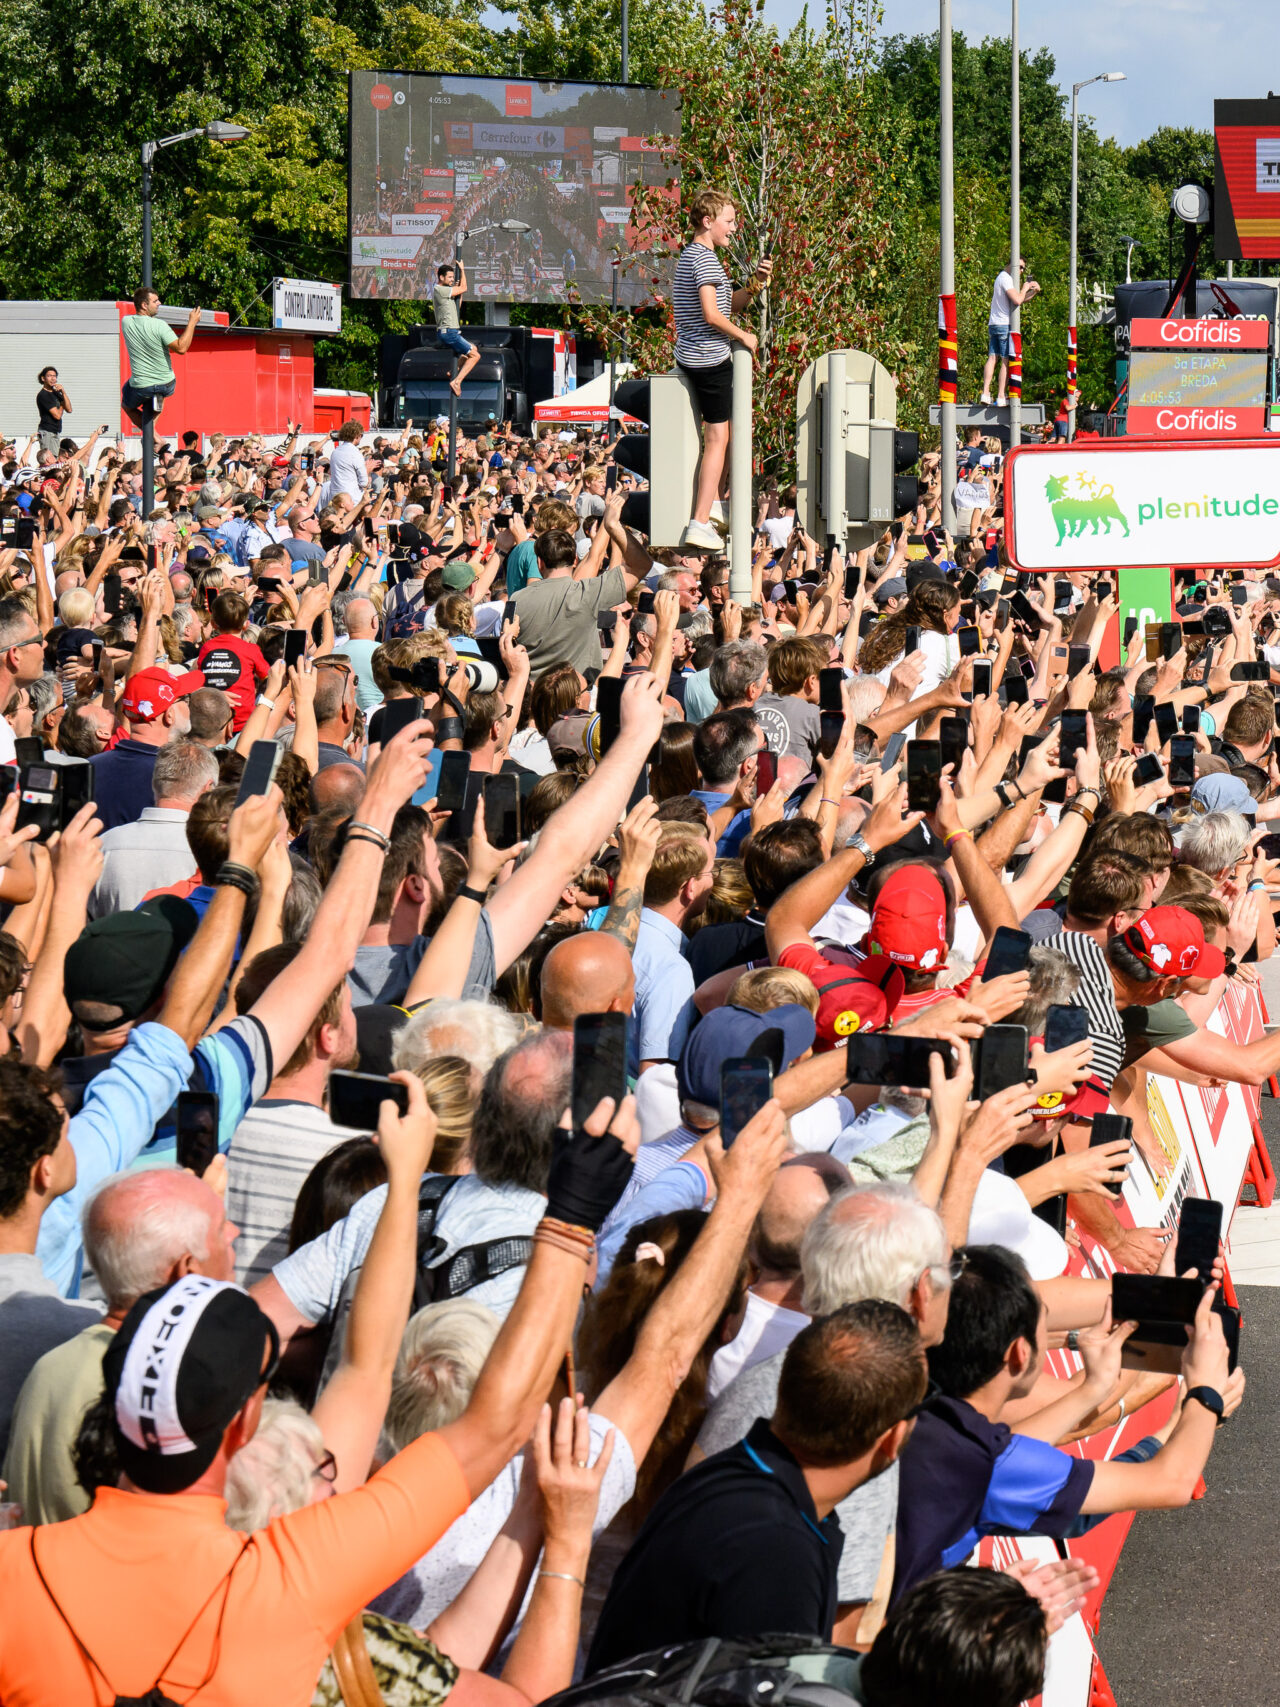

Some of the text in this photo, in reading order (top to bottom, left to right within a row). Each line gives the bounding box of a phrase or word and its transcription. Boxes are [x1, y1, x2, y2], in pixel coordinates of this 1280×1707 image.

[1160, 321, 1242, 343] Cofidis
[1191, 356, 1227, 370] ETAPA
[1181, 374, 1218, 387] BREDA
[1139, 391, 1182, 405] 4:05:53
[1156, 409, 1237, 431] Cofidis
[872, 508, 890, 517] 31.1
[1138, 493, 1280, 526] plenitude
